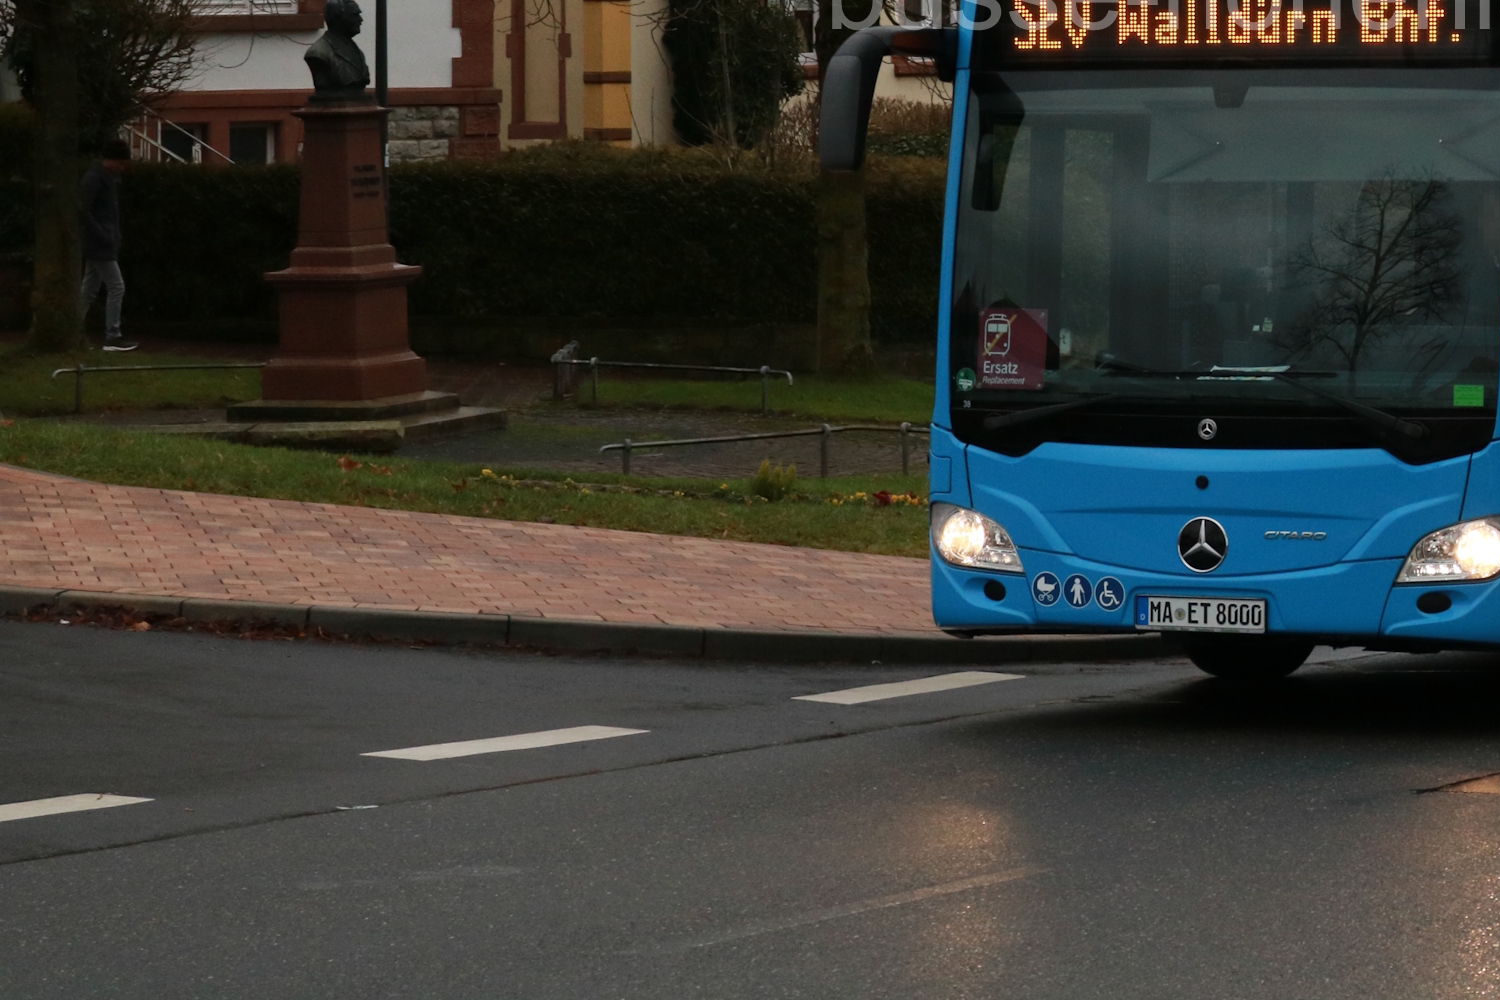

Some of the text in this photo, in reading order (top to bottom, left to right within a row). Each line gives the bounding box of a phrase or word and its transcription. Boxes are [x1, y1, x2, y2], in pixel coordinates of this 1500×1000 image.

[983, 360, 1019, 375] Ersatz
[982, 375, 1026, 385] Replacement
[1264, 530, 1327, 540] CITARO
[1150, 601, 1173, 623] MA
[1188, 602, 1211, 624] ET
[1216, 603, 1262, 626] 8000
